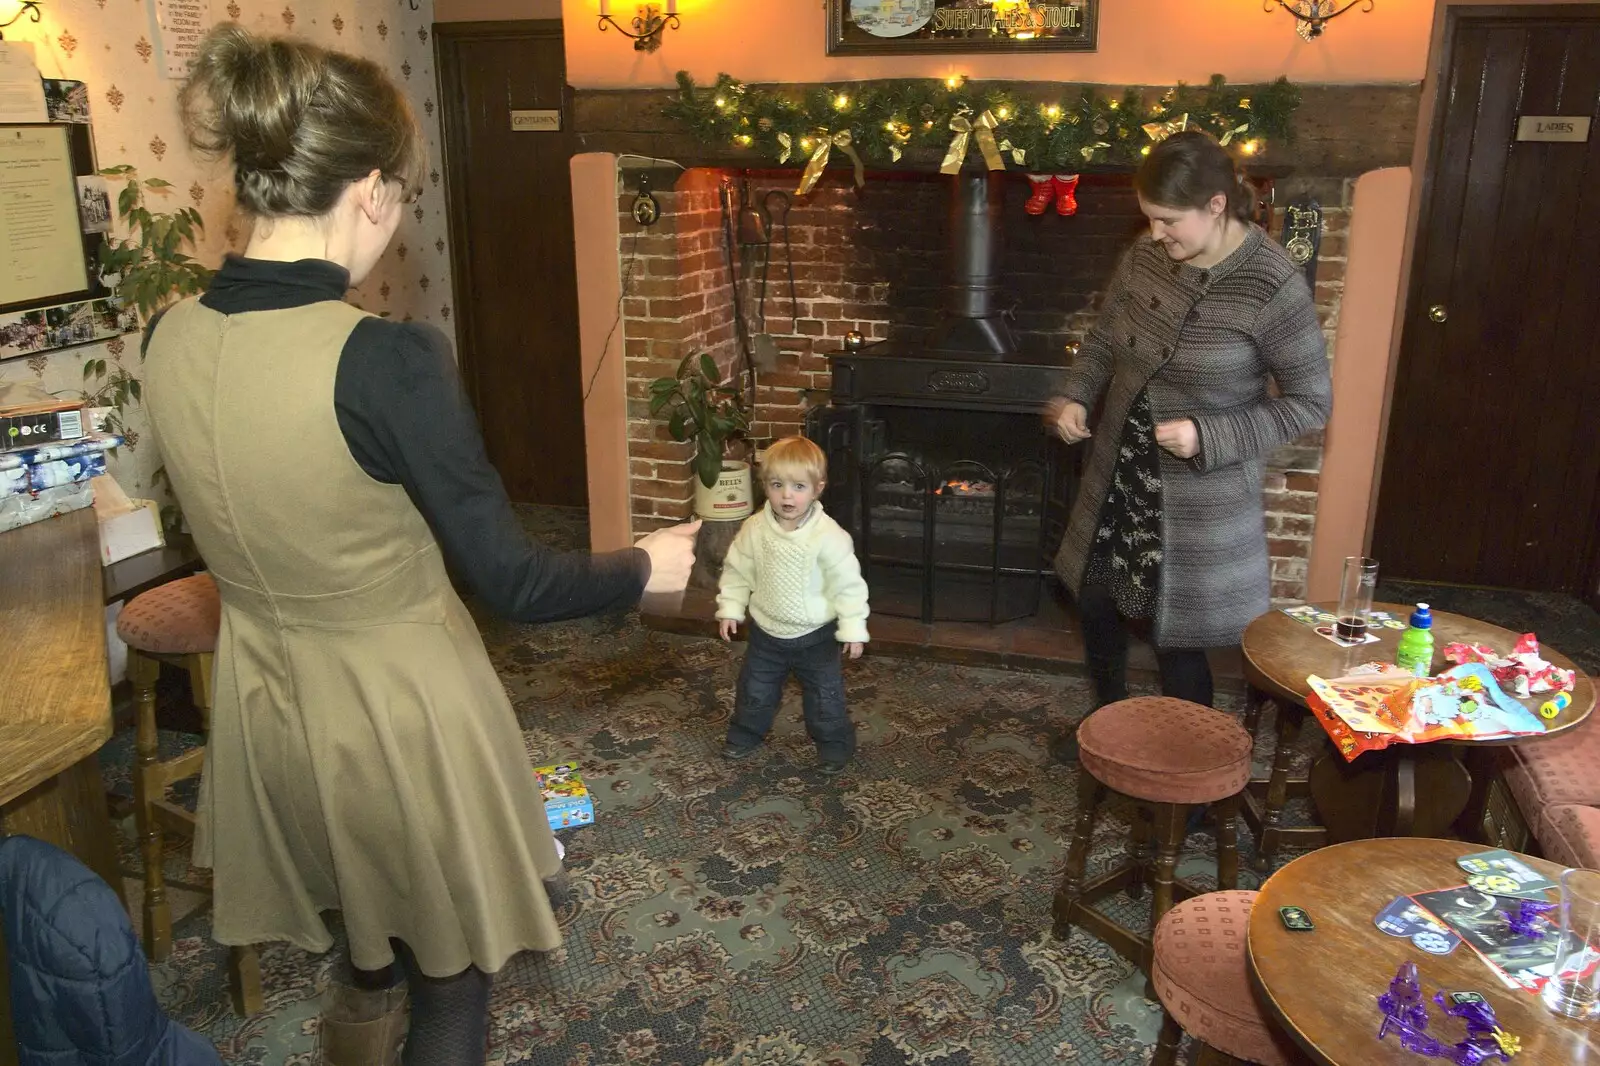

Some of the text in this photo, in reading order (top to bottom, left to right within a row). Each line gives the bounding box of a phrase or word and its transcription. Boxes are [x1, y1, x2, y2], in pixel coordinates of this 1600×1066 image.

[936, 8, 992, 30] SUFFOLK
[1026, 14, 1036, 27] &
[1035, 4, 1080, 28] STOUT.
[514, 116, 556, 125] GENTLEMEN
[1536, 122, 1574, 133] LADIES
